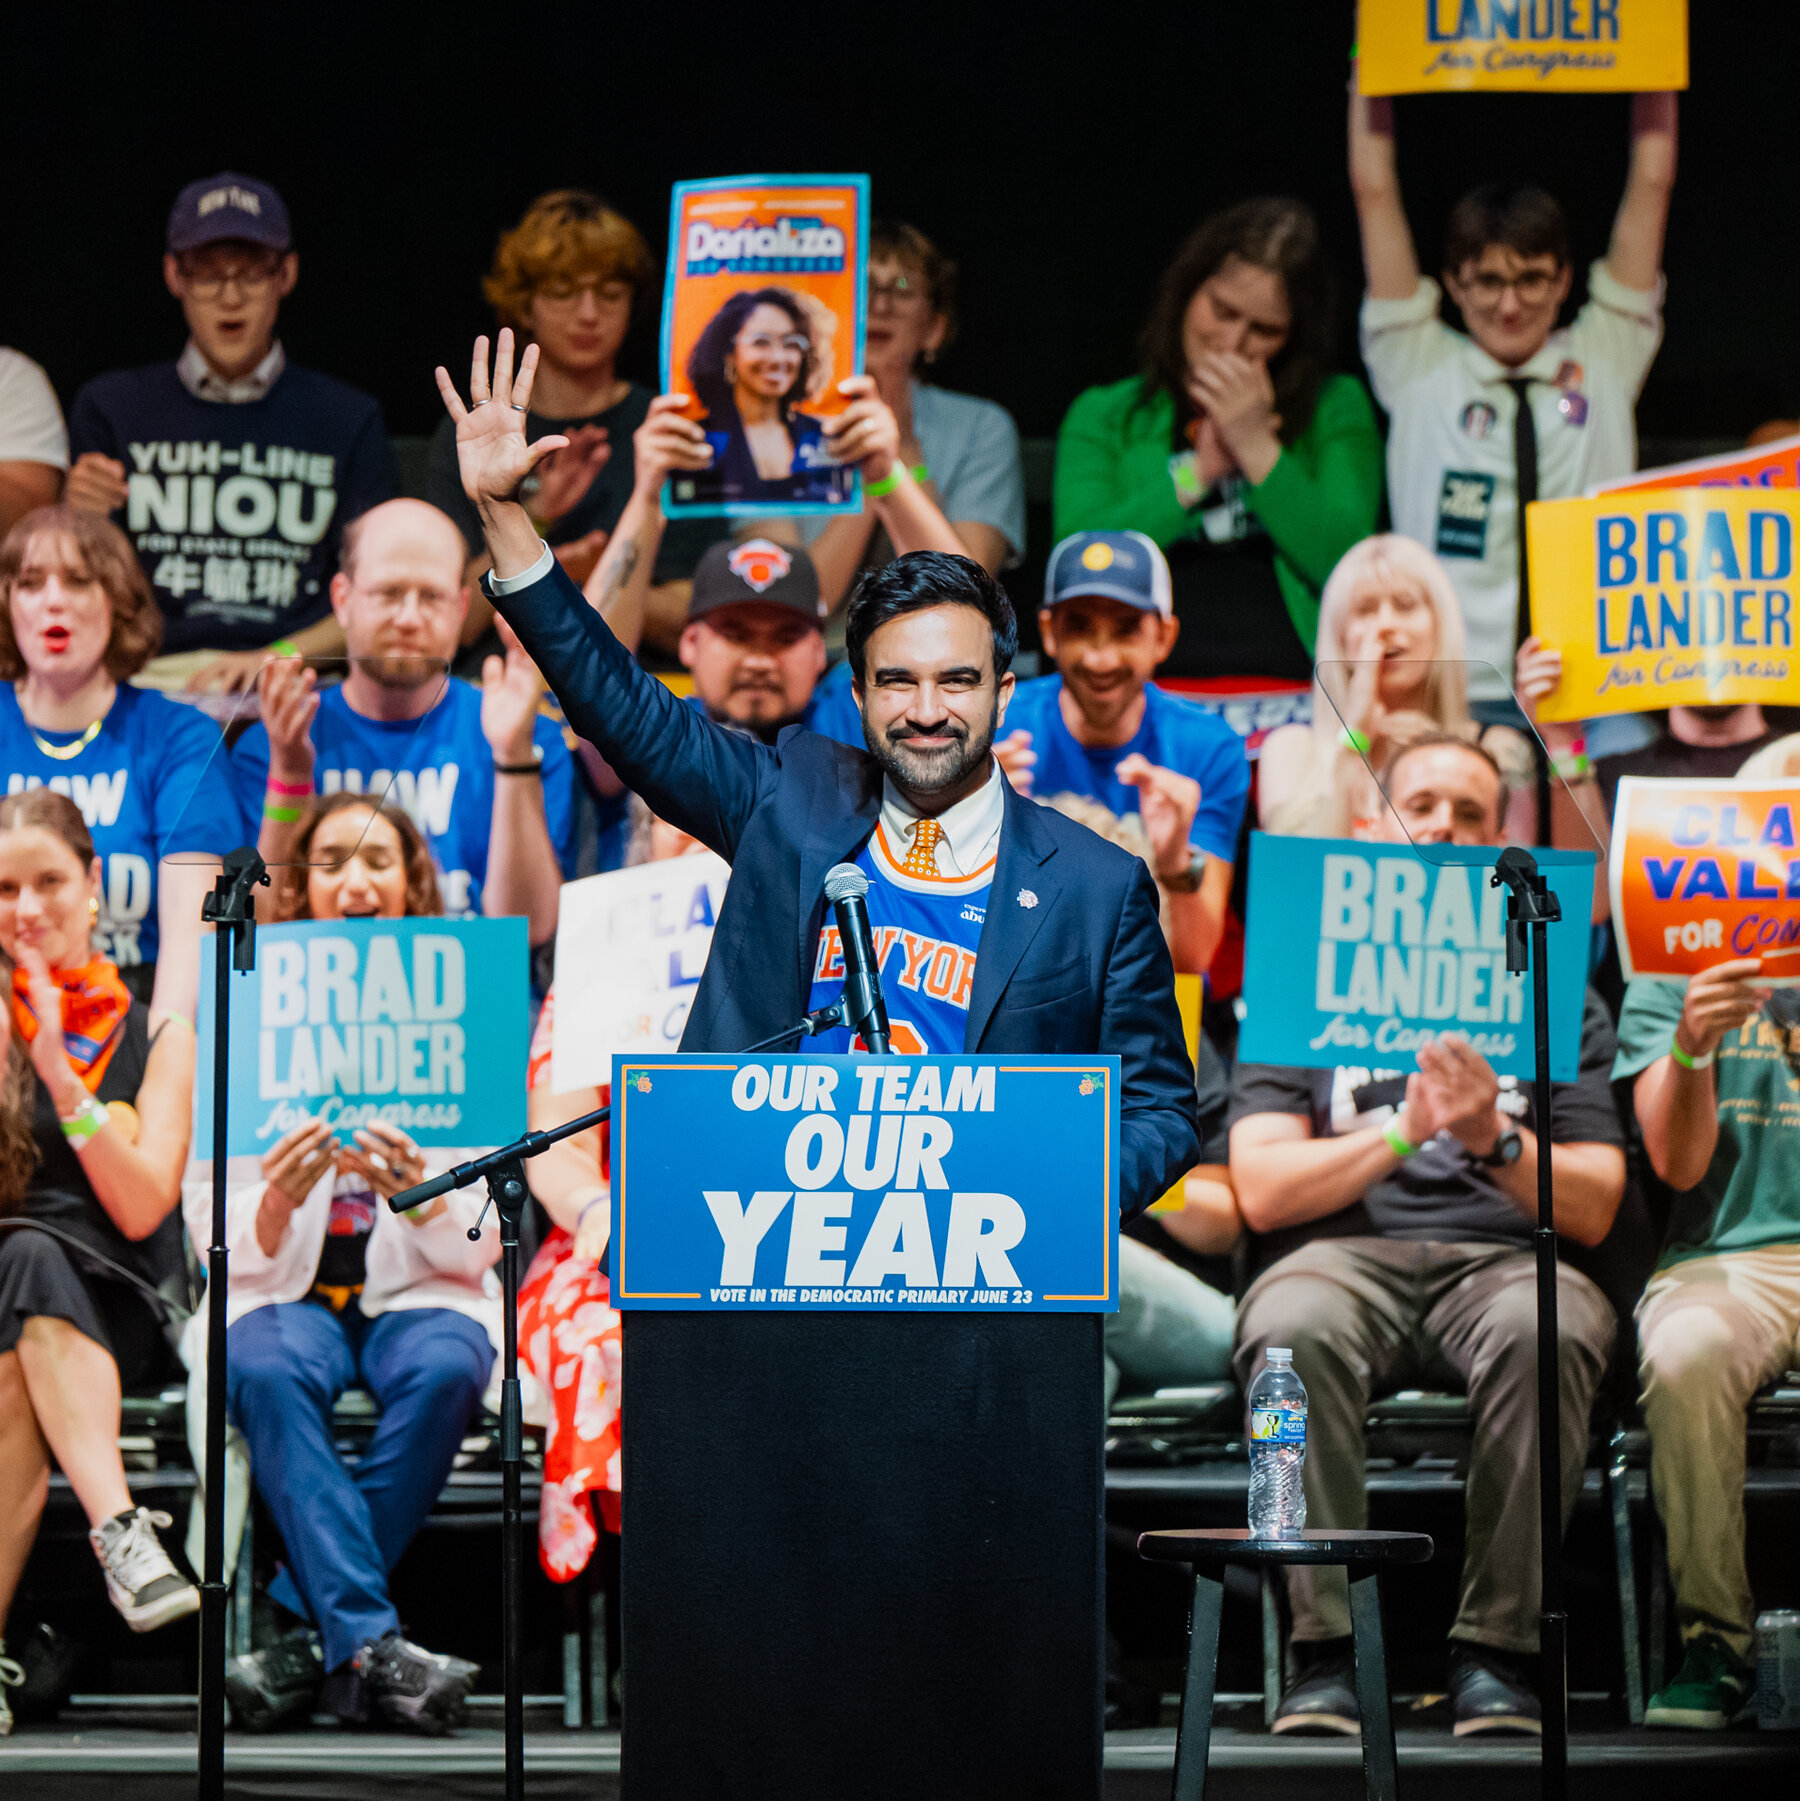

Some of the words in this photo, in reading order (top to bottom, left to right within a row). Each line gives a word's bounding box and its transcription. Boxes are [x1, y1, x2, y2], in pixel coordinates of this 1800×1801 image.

[1426, 0, 1619, 42] LANDER
[1423, 49, 1475, 77] for
[1483, 46, 1618, 80] Congress
[128, 441, 335, 487] YUH-LINE
[127, 472, 339, 545] NIOU
[1597, 510, 1794, 589] BRAD
[1597, 590, 1792, 655] LANDER
[1596, 664, 1646, 696] for
[1653, 655, 1790, 690] Congress
[1670, 803, 1796, 849] CLA
[1663, 918, 1724, 956] FOR
[260, 934, 466, 1029] BRAD
[1315, 940, 1527, 1024] LANDER
[1309, 1014, 1372, 1051] for
[258, 1022, 467, 1101] LANDER
[731, 1064, 839, 1112] OUR
[855, 1065, 996, 1112] TEAM
[784, 1113, 954, 1191] OUR
[702, 1191, 1027, 1288] YEAR
[710, 1288, 747, 1303] VOTE
[749, 1288, 768, 1303] IN
[770, 1288, 798, 1303] THE
[799, 1288, 895, 1304] DEMOCRATIC
[897, 1288, 967, 1304] PRIMARY
[970, 1289, 1009, 1304] JUNE
[1012, 1289, 1033, 1304] 23
